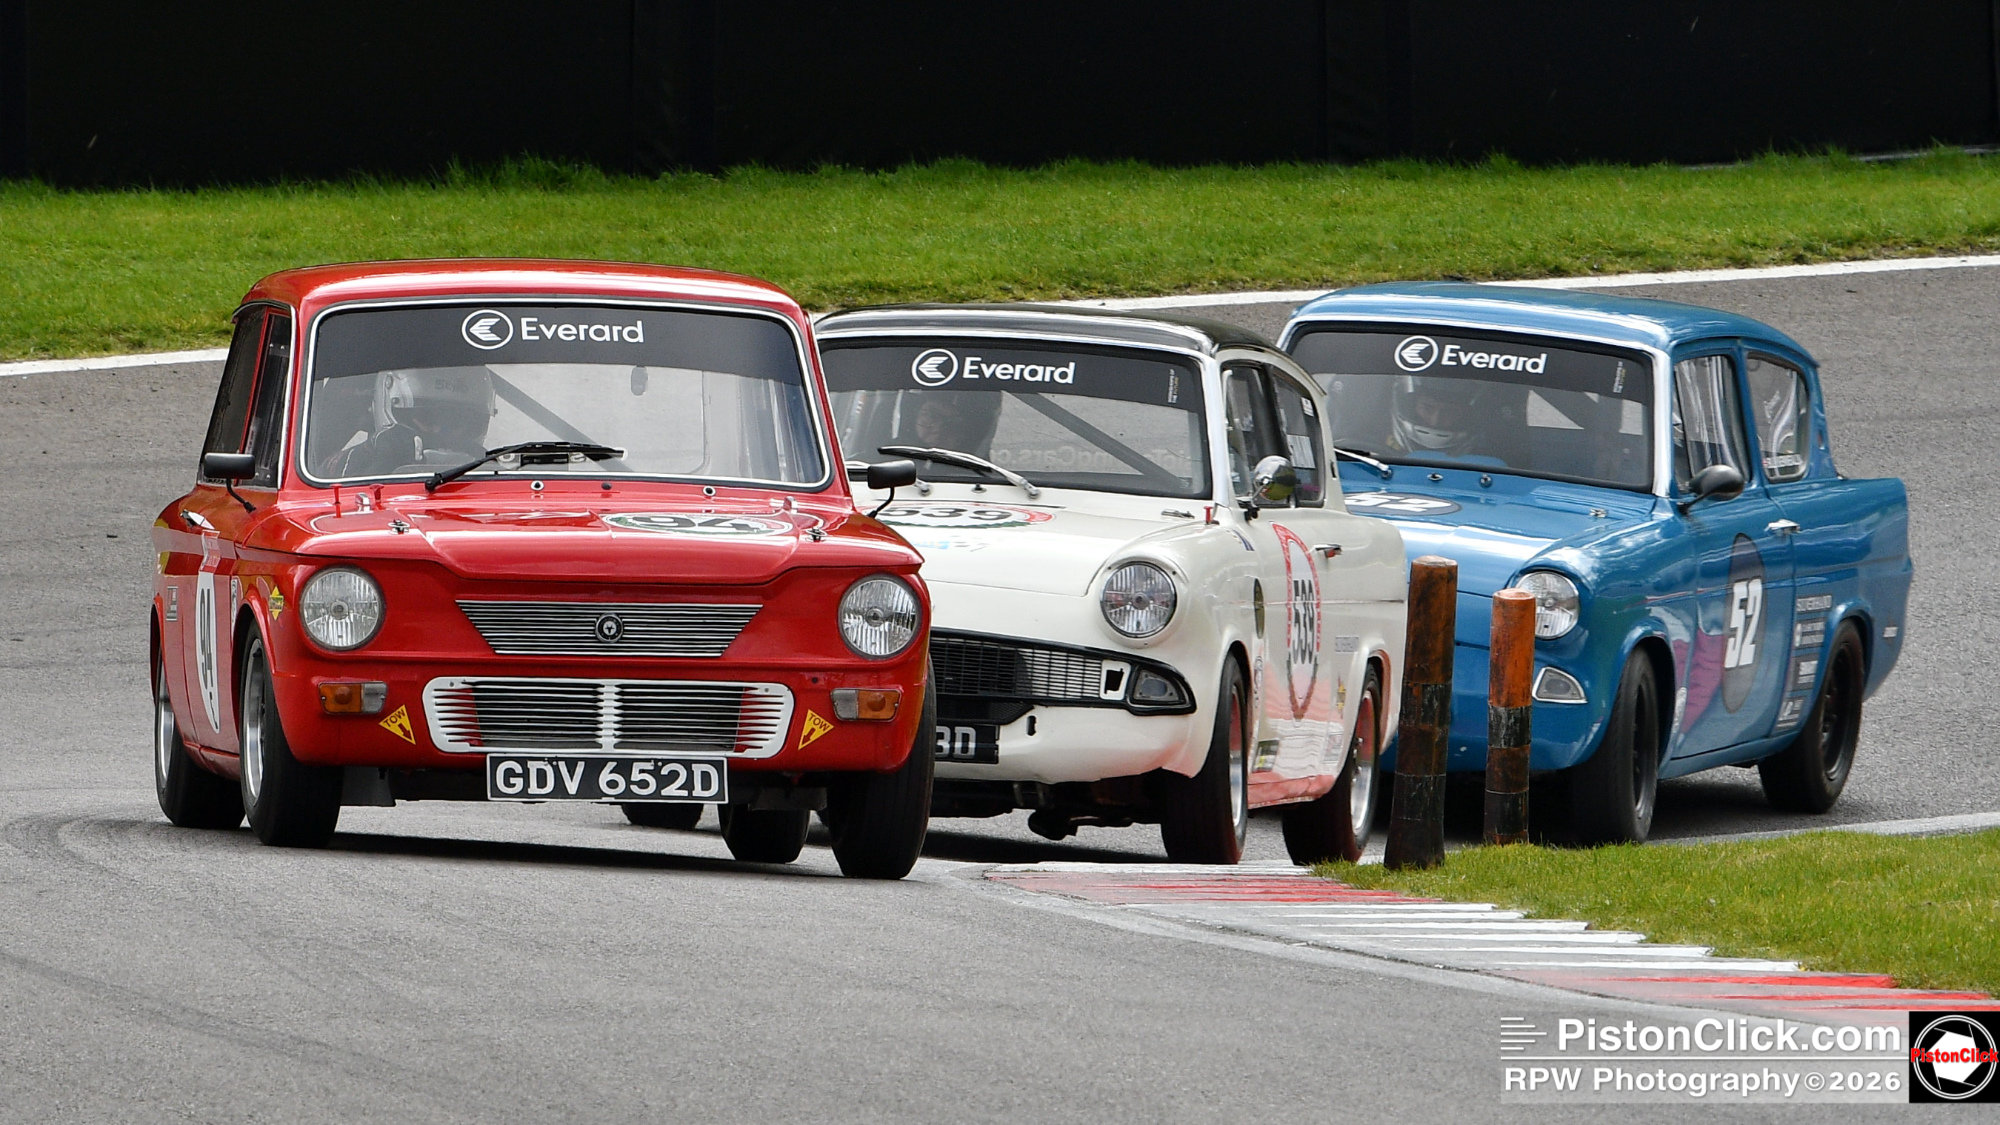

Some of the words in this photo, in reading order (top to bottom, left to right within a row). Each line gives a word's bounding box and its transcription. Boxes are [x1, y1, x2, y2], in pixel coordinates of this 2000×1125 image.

[520, 317, 645, 343] Everard
[962, 356, 1076, 384] Everard
[1441, 344, 1548, 374] Everard
[878, 506, 1012, 521] 539
[1344, 492, 1452, 513] 52
[632, 515, 761, 531] 94
[1293, 579, 1316, 665] 539
[1724, 577, 1763, 669] 52
[384, 707, 406, 728] TOW
[808, 711, 831, 732] TOW
[496, 760, 585, 796] GDV
[598, 760, 720, 798] 652D
